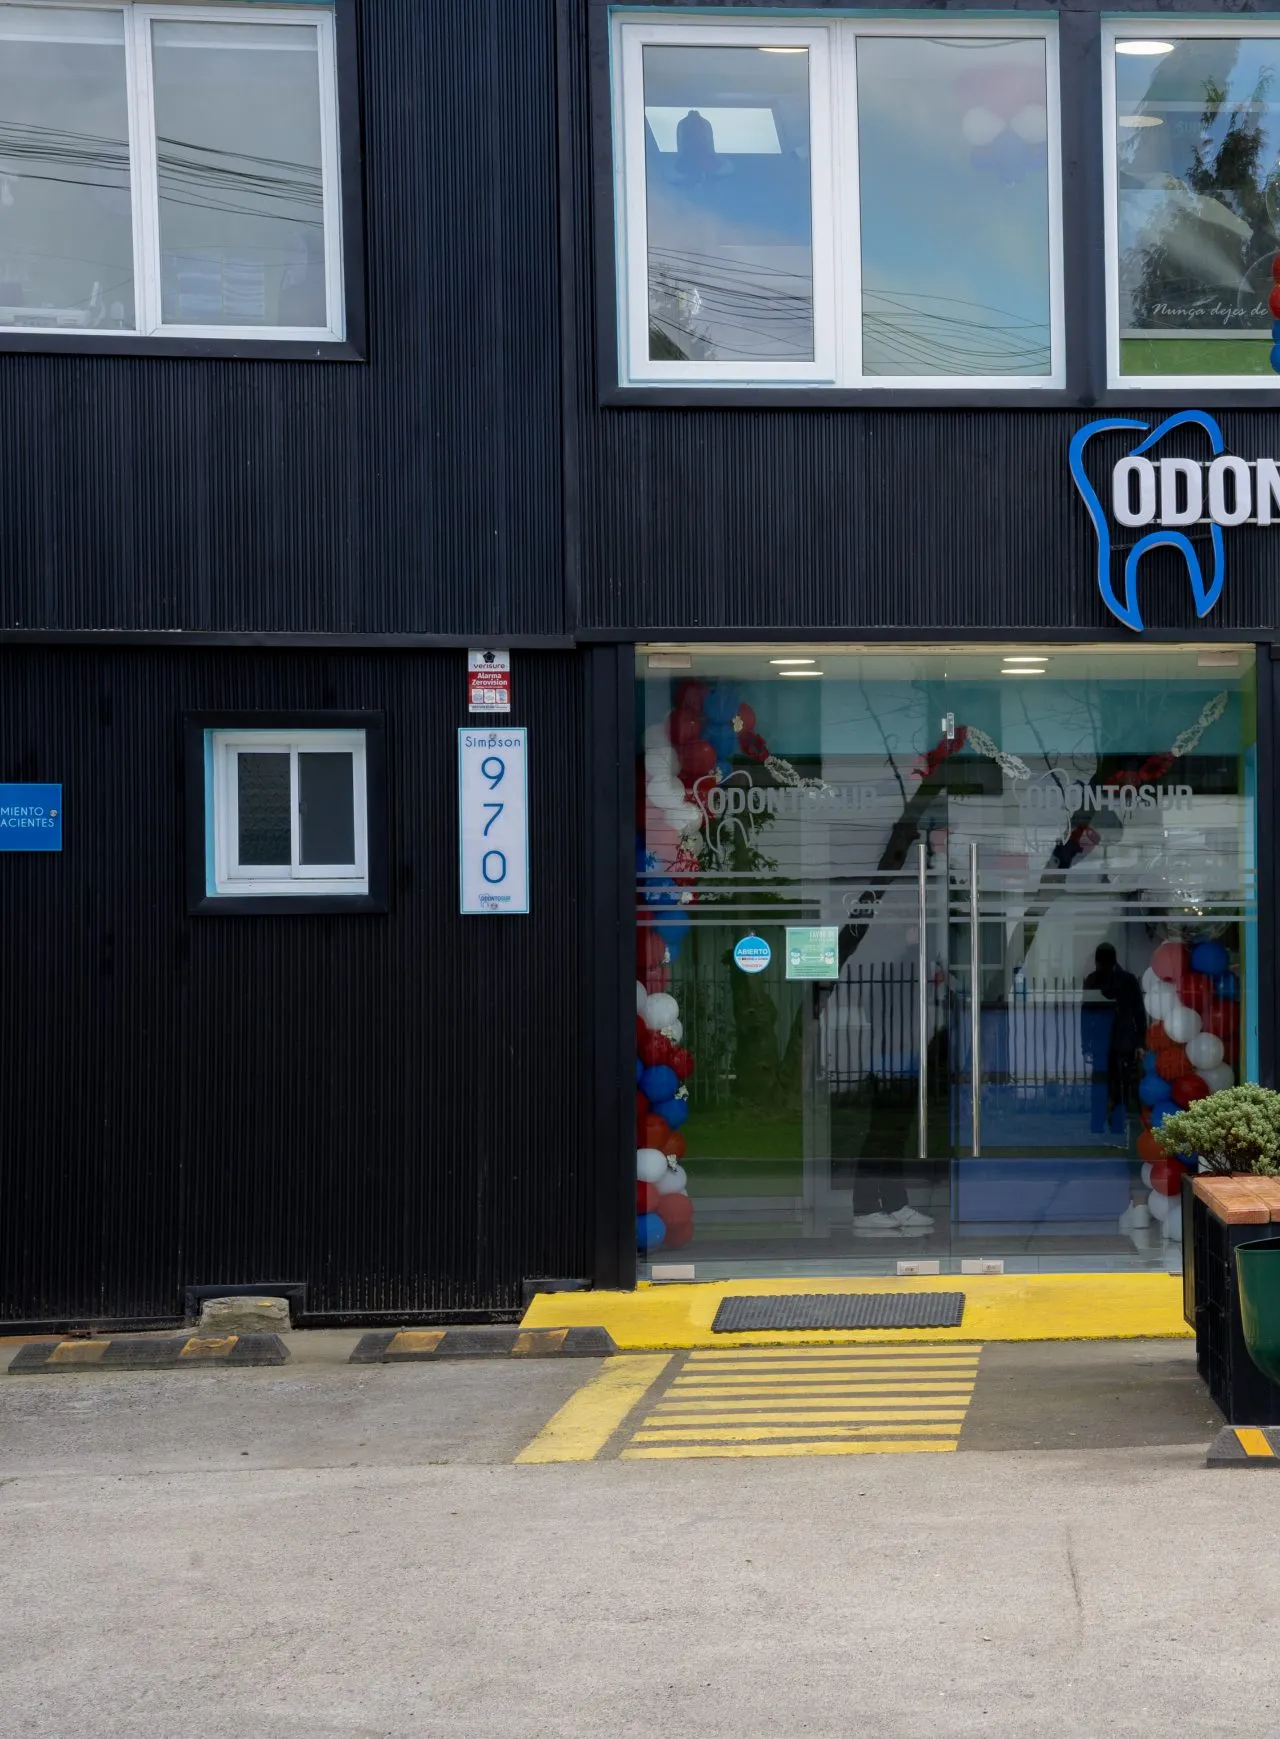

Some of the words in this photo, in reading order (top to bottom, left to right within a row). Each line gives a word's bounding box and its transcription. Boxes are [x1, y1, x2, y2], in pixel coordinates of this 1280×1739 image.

[1210, 302, 1246, 325] dejes
[1250, 302, 1269, 316] de
[471, 678, 508, 686] Zerovision
[465, 736, 521, 750] Simpson
[1025, 784, 1194, 812] ODONTOSUR
[737, 948, 768, 956] ABIERTO
